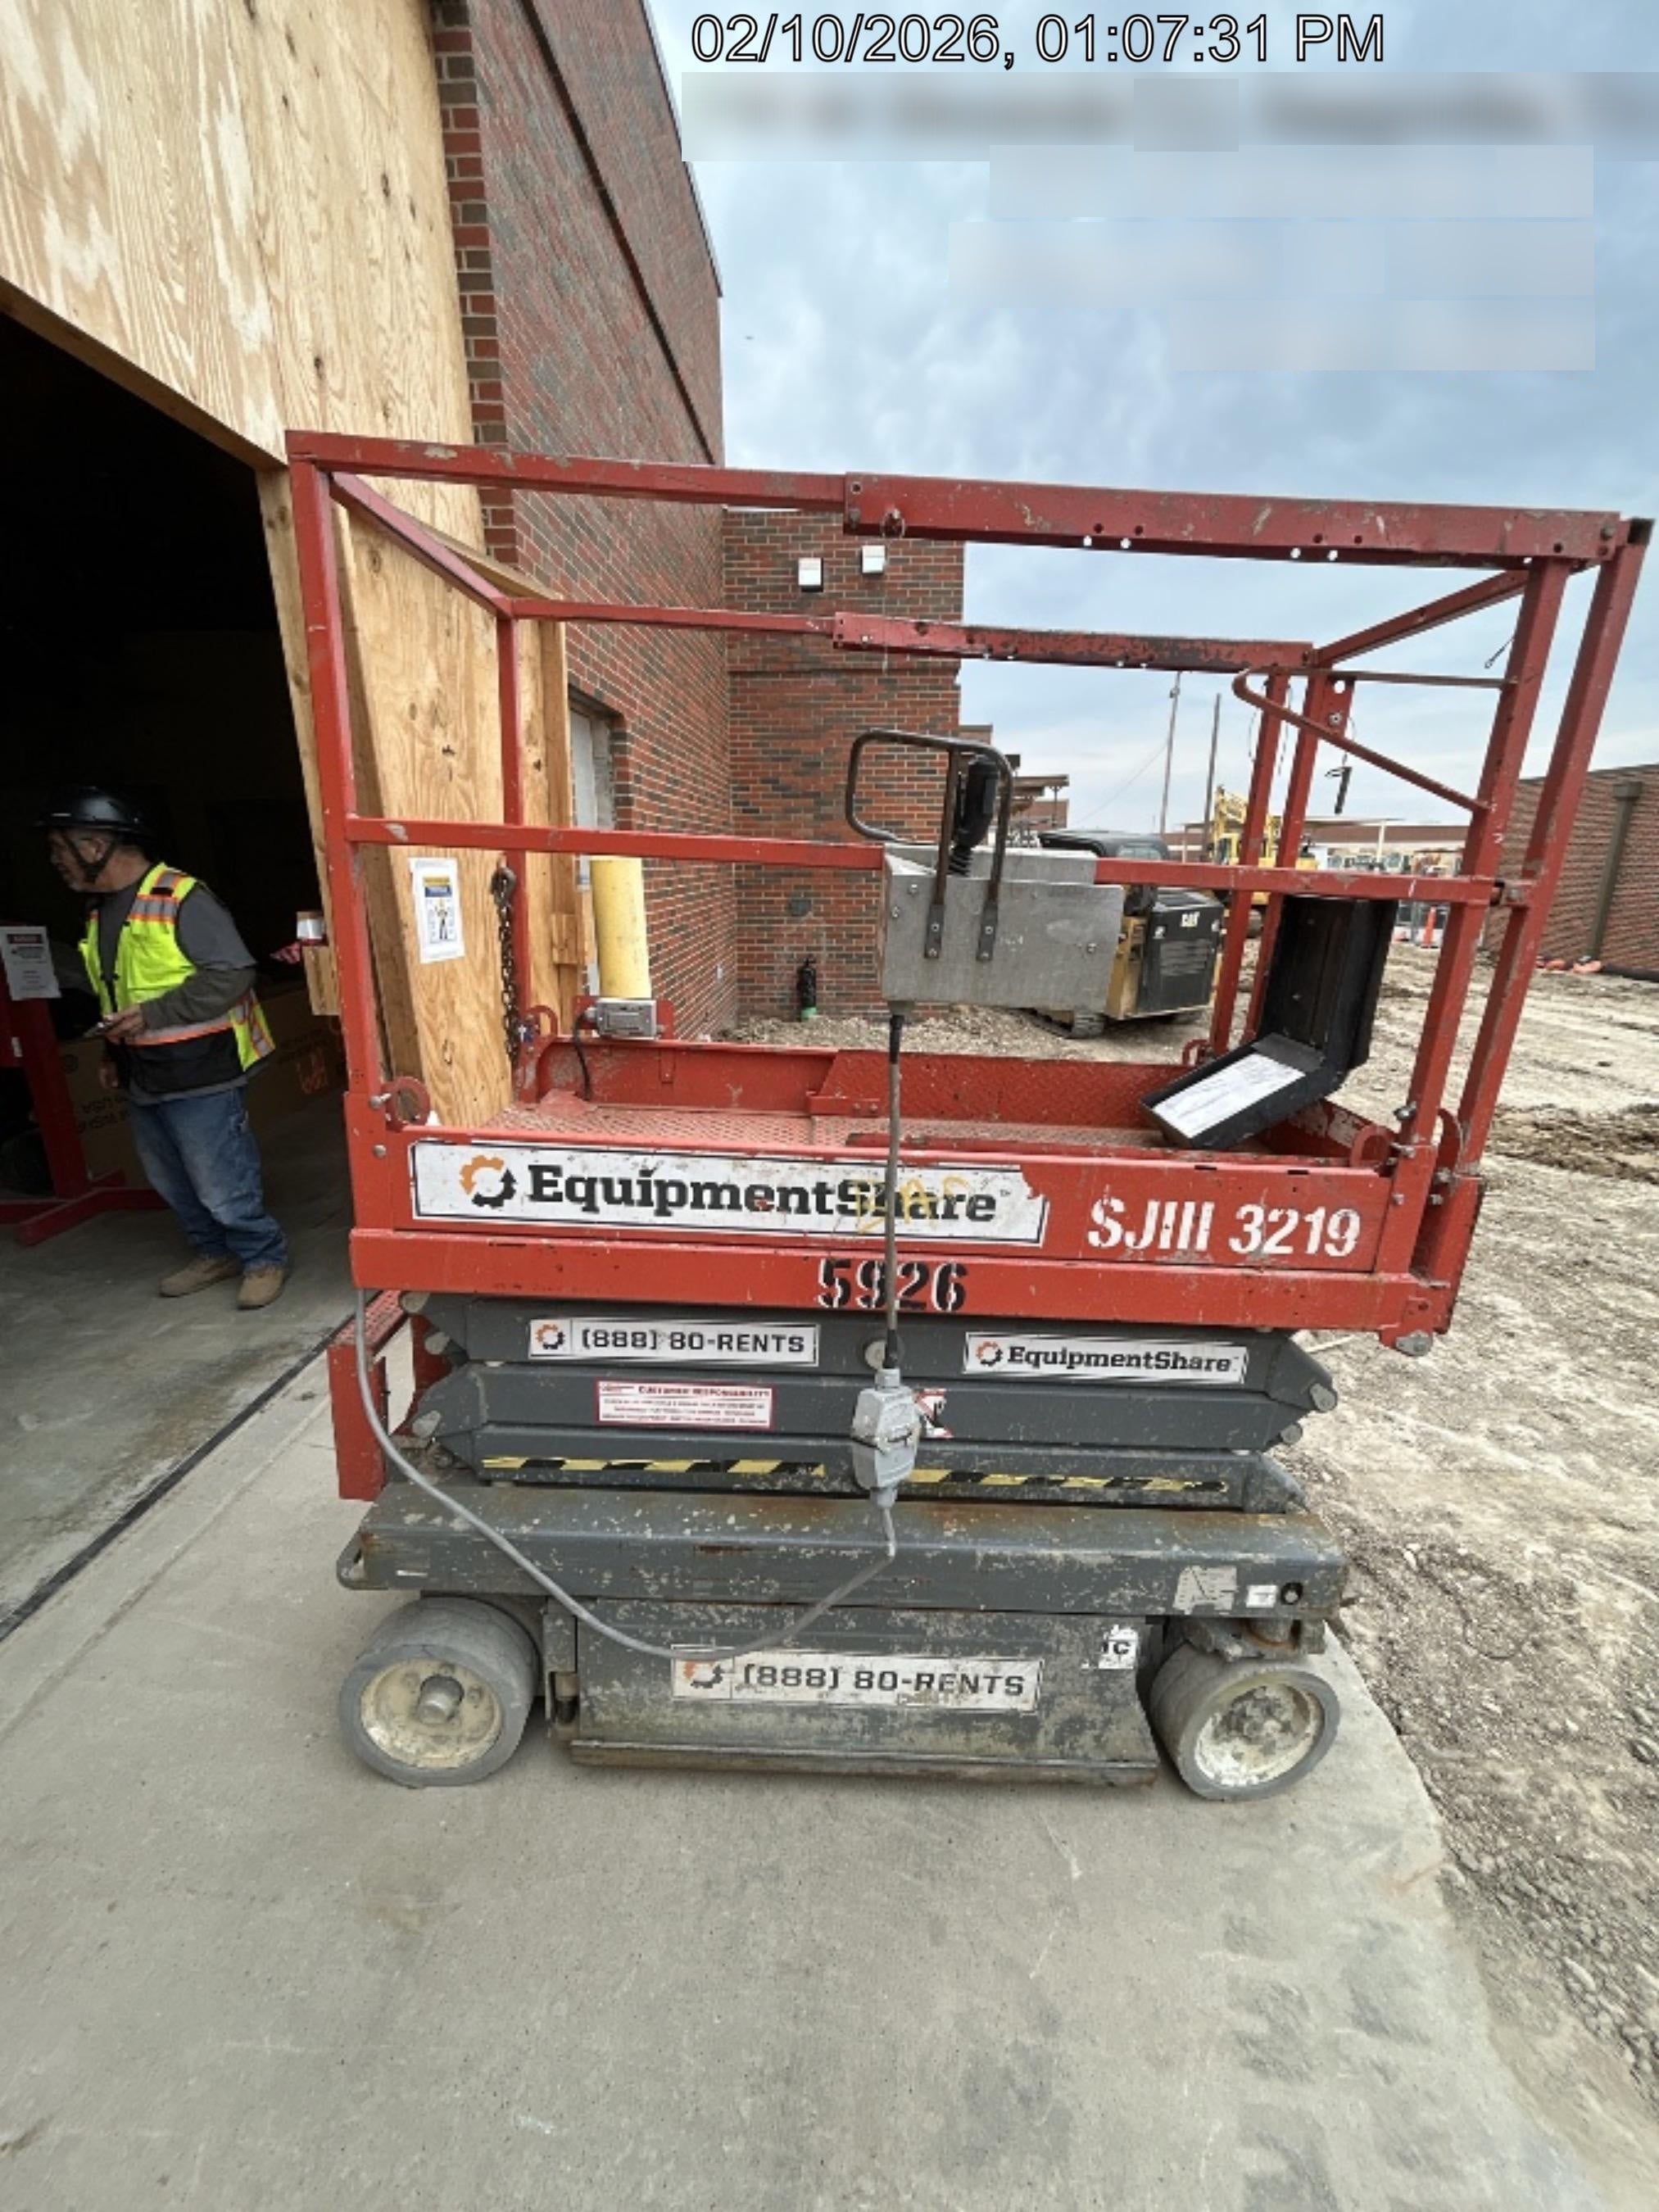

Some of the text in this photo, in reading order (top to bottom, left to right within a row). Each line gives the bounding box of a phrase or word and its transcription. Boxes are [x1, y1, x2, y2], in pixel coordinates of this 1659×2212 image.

[528, 1163, 997, 1222] EquipmentShare
[1229, 1203, 1361, 1257] 3219
[818, 1258, 968, 1312] 5926
[581, 1328, 806, 1354] (888) 80-RENTS
[1007, 1344, 1231, 1373] EquipmentShare
[744, 1663, 1026, 1697] (888) 80-RENTS
